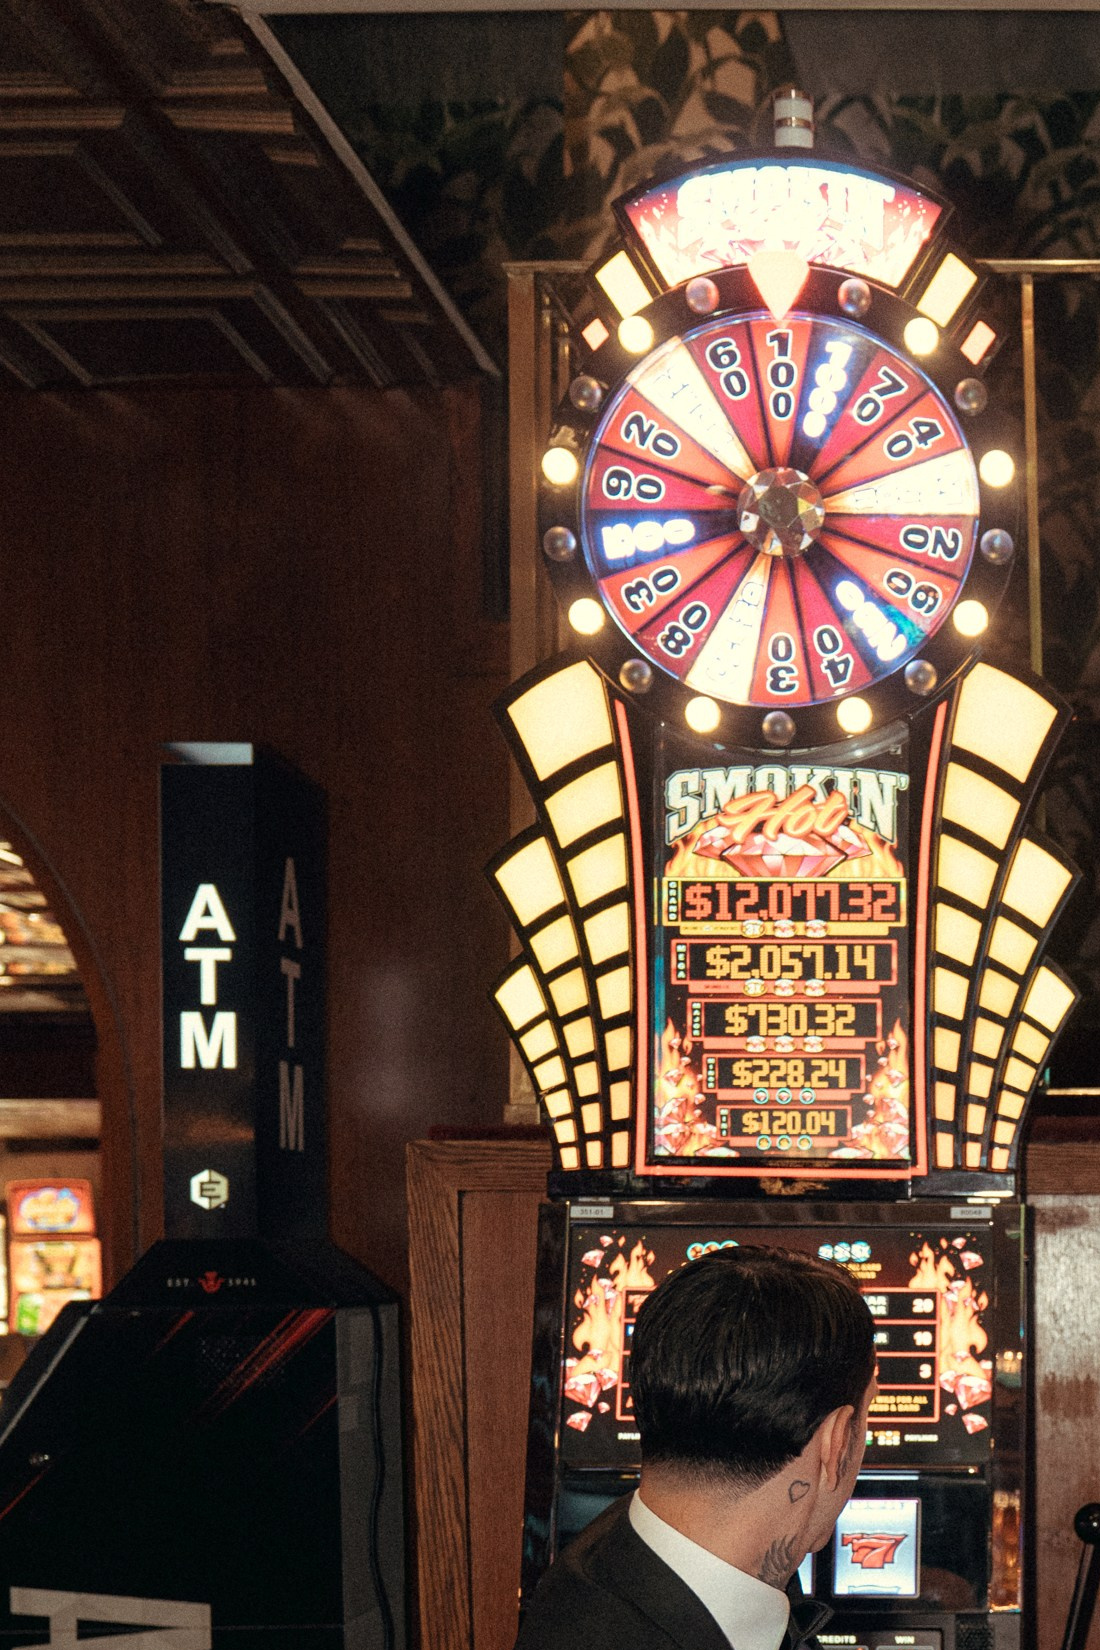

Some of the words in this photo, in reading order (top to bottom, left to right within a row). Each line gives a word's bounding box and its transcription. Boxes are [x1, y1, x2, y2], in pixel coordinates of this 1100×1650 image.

[706, 337, 749, 399] 60
[766, 328, 798, 420] 100
[853, 366, 907, 425] 70
[620, 411, 681, 460] 20
[884, 417, 943, 460] 40
[900, 524, 963, 561] 20
[621, 565, 681, 613] 30
[656, 601, 710, 658] 80
[766, 632, 799, 694] 30
[813, 624, 855, 687] 40
[716, 783, 850, 844] Hot
[685, 883, 896, 920] $12,077.32
[178, 884, 237, 1069] ATM
[676, 944, 687, 978] MEGA
[705, 944, 876, 979] $2,057.14
[277, 857, 304, 1151] ATM
[725, 1003, 856, 1036] $730.32
[731, 1059, 846, 1088] $228.24
[742, 1110, 836, 1135] $120.04
[912, 1298, 934, 1313] 20
[913, 1331, 933, 1346] 10
[919, 1363, 932, 1379] 3
[895, 1635, 915, 1644] WIN
